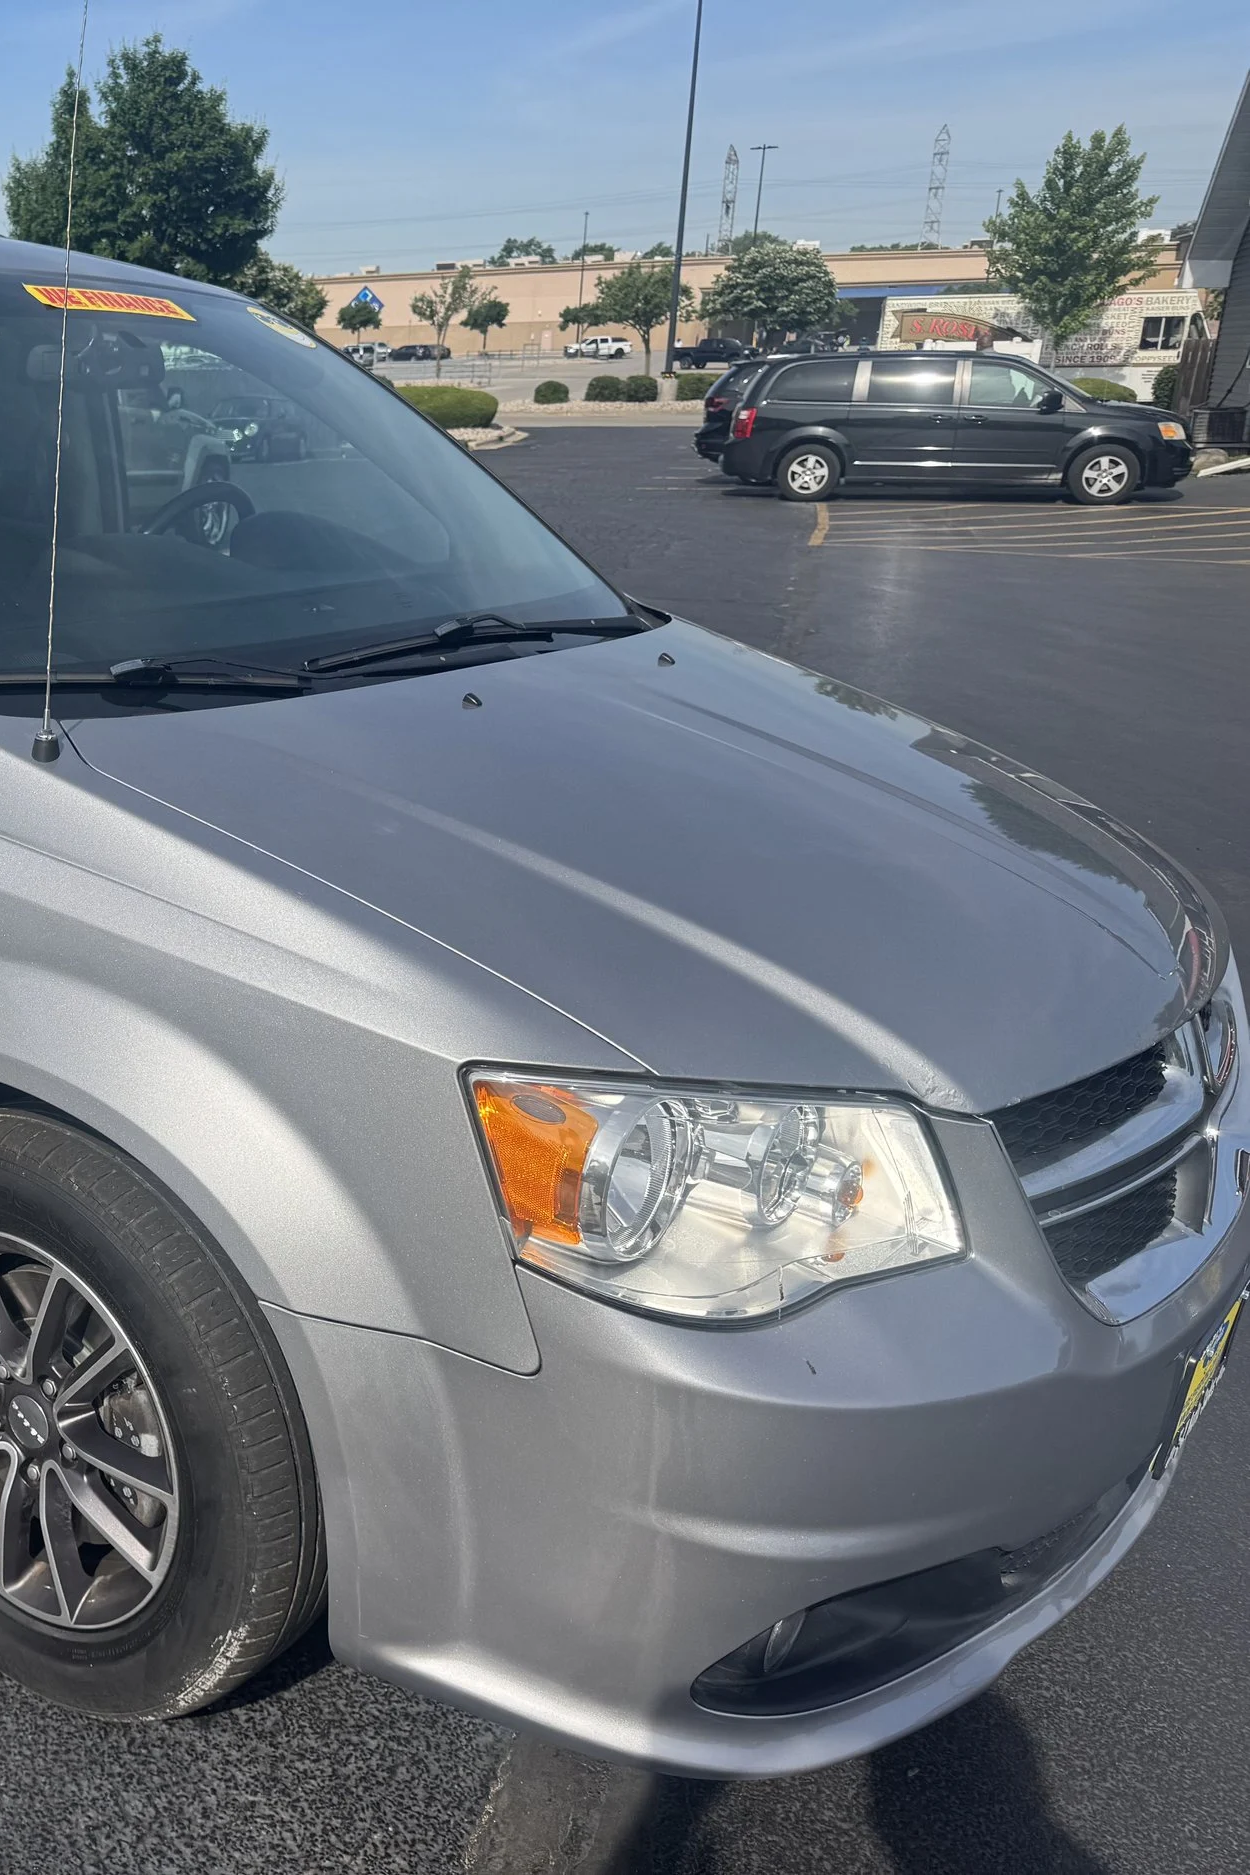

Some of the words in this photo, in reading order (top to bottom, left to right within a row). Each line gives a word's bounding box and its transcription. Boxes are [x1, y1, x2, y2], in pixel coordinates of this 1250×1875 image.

[33, 287, 87, 307] WE
[79, 289, 181, 316] FINANCE
[1146, 296, 1191, 306] BAKERY
[1086, 343, 1117, 351] ROLLS
[1055, 355, 1089, 364] SINCE
[1089, 355, 1117, 363] 1909
